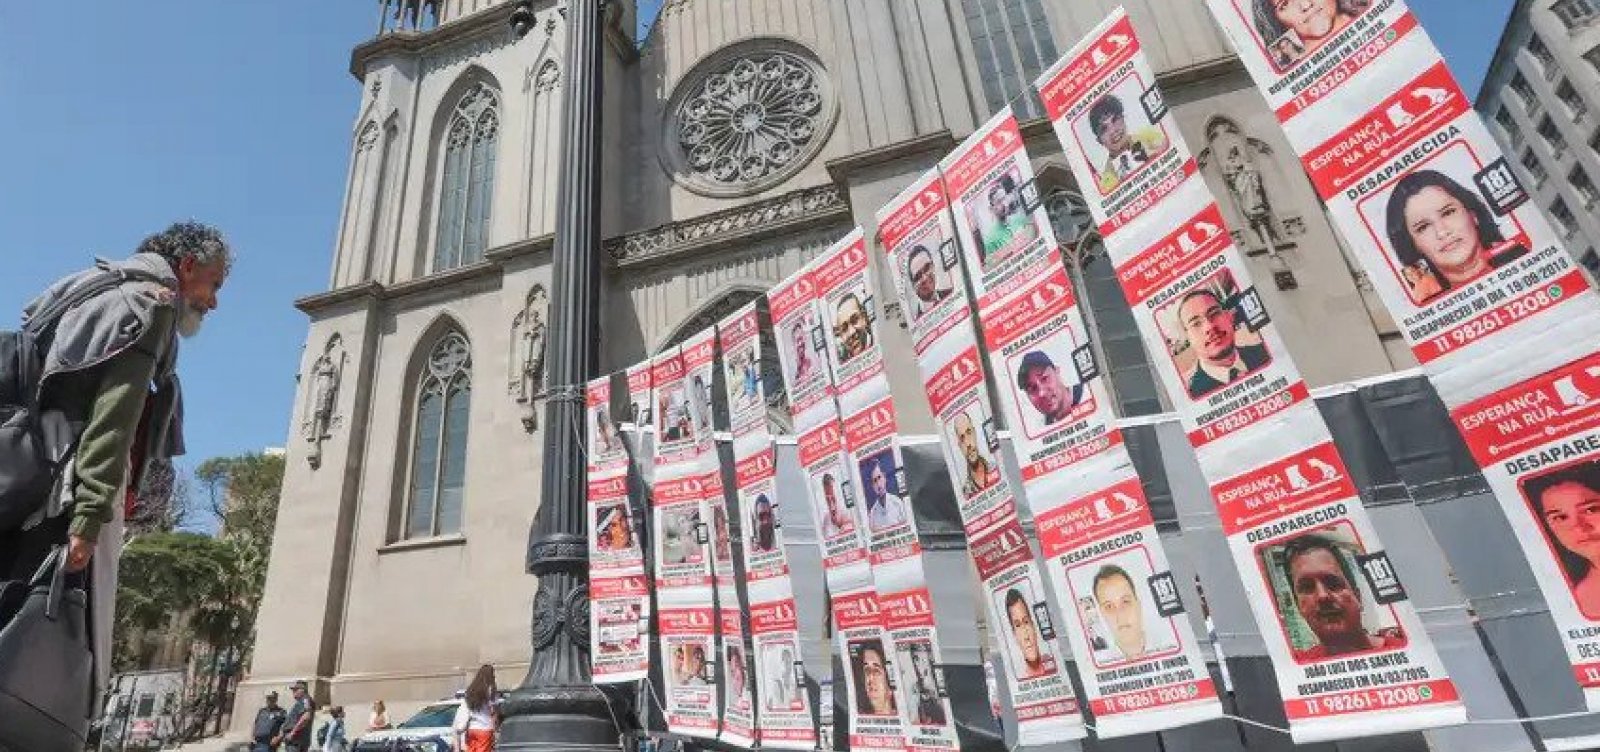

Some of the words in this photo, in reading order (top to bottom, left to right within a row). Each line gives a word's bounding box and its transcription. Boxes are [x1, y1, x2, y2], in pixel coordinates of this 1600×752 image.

[1065, 60, 1136, 122] DESAPARECIDO
[1296, 94, 1307, 110] 11
[1308, 38, 1386, 99] 98261-1208
[1310, 119, 1383, 171] ESPERANÇA
[1342, 149, 1365, 168] NA
[1363, 131, 1391, 155] RUA
[1346, 124, 1461, 202] DESAPARECIDA
[1481, 163, 1512, 195] 181
[1146, 254, 1227, 309] DESAPARECIDO
[1409, 303, 1472, 341] DESAPARECEU
[1470, 296, 1490, 317] NO
[1485, 287, 1507, 306] DIA
[1437, 337, 1450, 352] 11
[1451, 293, 1551, 342] 98261-1208
[1002, 313, 1068, 356] DESAPARECIDO
[1460, 389, 1549, 431] ESPERANÇA
[1497, 417, 1523, 436] NA
[1521, 404, 1559, 426] RUA
[1203, 427, 1216, 441] 11
[1504, 433, 1600, 476] DESAPARE
[1218, 473, 1284, 504] ESPERANÇA
[1244, 496, 1265, 511] NA
[1263, 487, 1290, 504] RUA
[1246, 503, 1348, 543] DESAPARECIDO
[1060, 530, 1143, 565] DESAPARECIDO
[1364, 557, 1392, 584] 181
[1152, 576, 1176, 603] 181
[1346, 657, 1370, 673] DOS
[1368, 651, 1411, 670] SANTOS
[1297, 676, 1356, 696] DESAPARECEU
[1354, 672, 1372, 689] EM
[1304, 698, 1320, 715] 11
[1322, 686, 1421, 712] 98261-1208
[1104, 699, 1116, 712] 11
